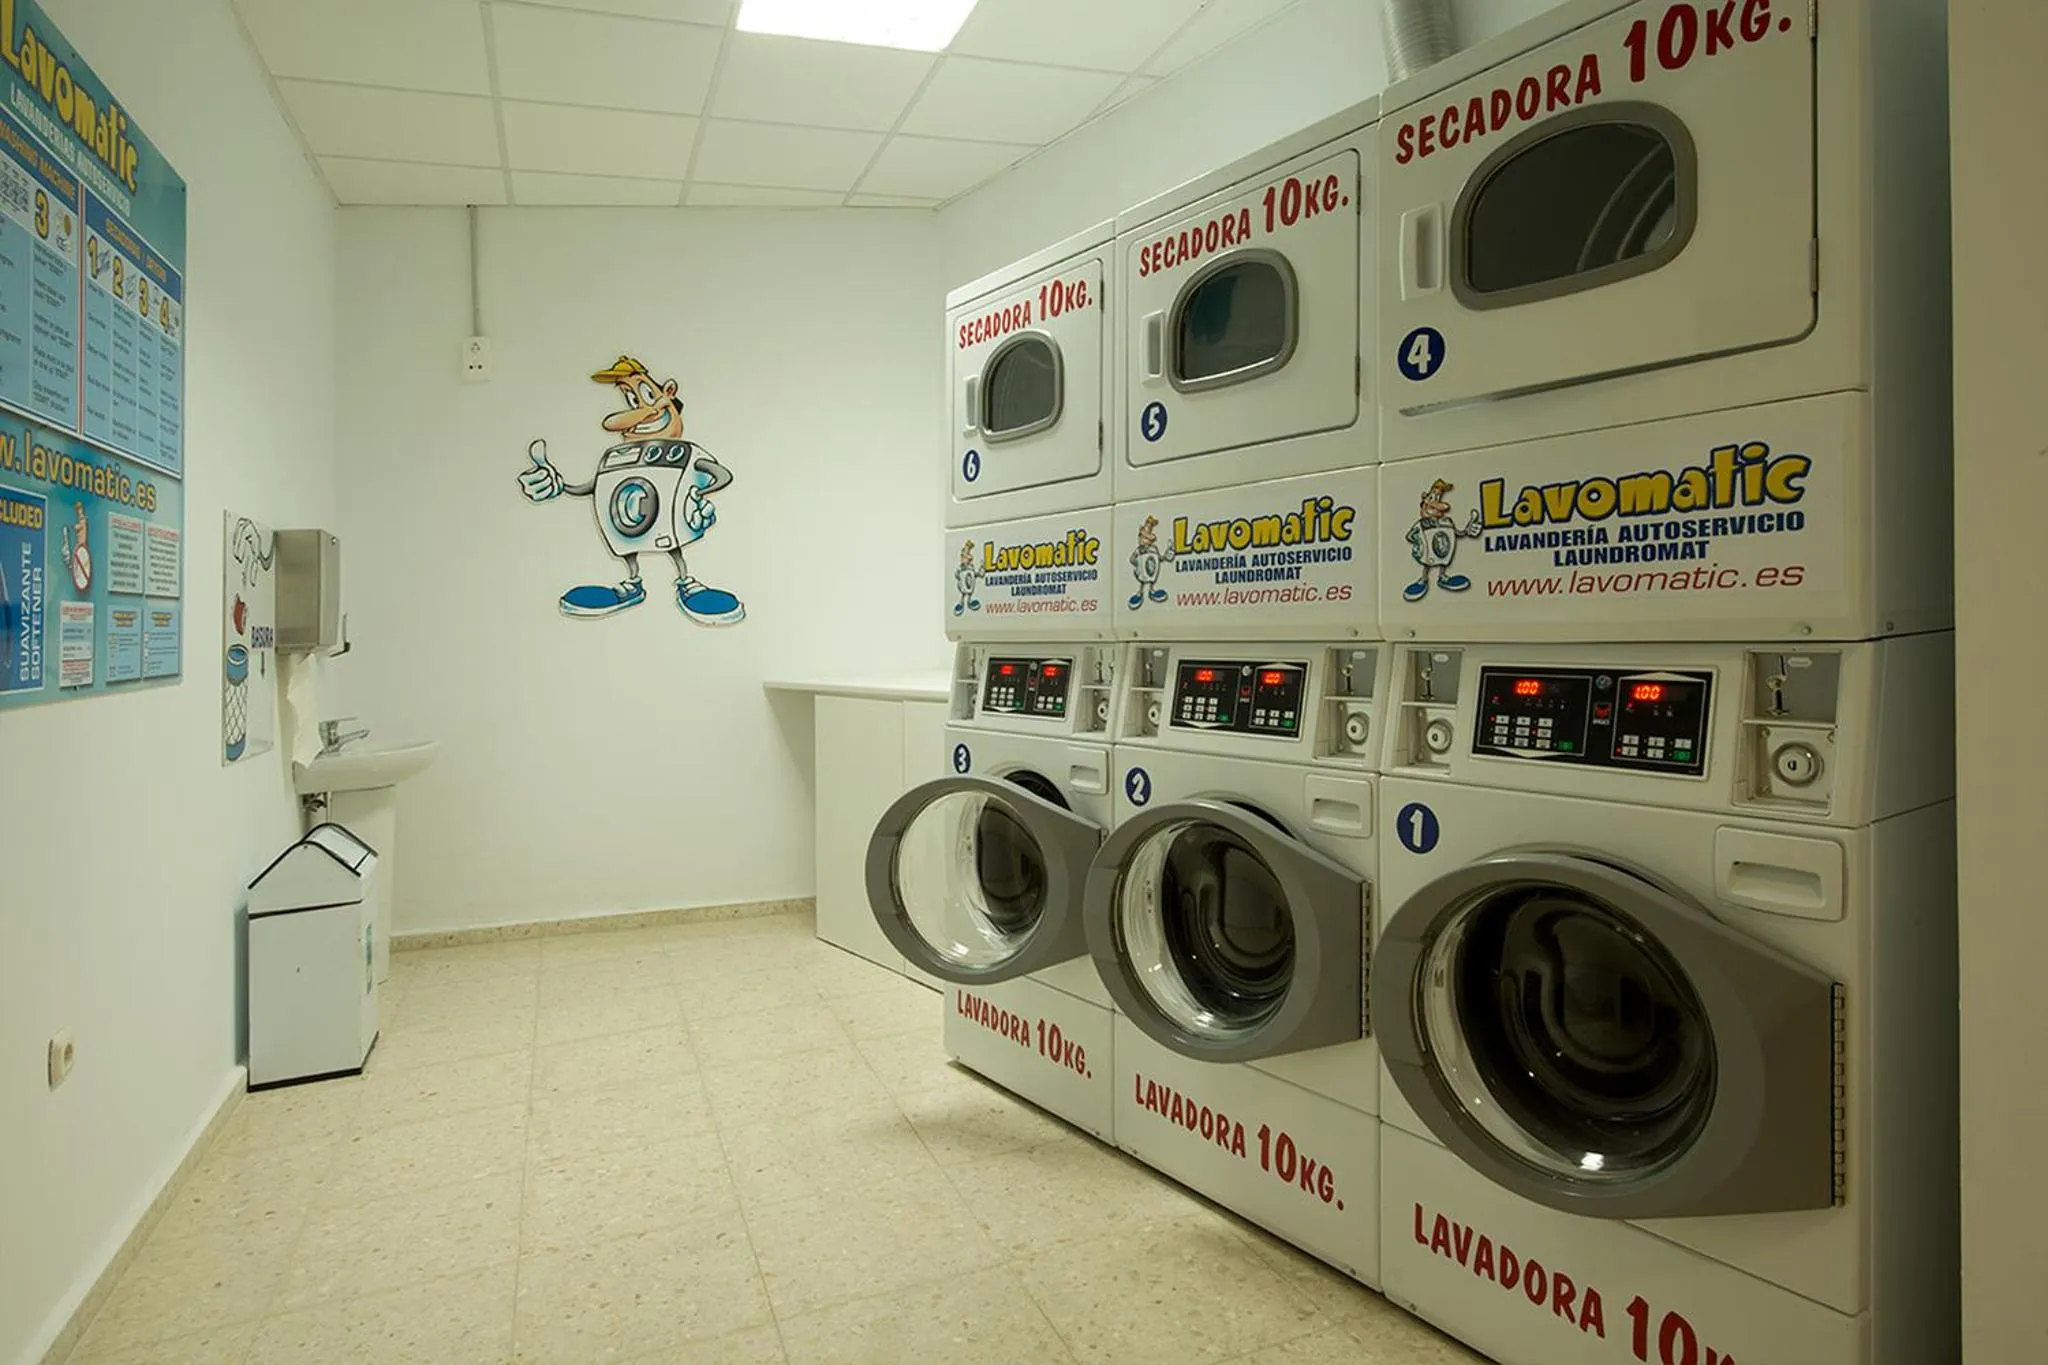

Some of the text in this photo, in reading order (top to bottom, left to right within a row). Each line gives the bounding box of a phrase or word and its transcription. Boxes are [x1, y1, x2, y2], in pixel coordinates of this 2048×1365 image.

[0, 0, 139, 196] Lavomatic
[1396, 54, 1602, 164] SECADORA
[35, 188, 49, 239] 3
[1139, 175, 1349, 277] SECADORA 10KG.
[88, 235, 98, 279] 1
[113, 256, 124, 299] 2
[139, 277, 149, 318] 3
[160, 296, 169, 334] 4
[958, 279, 1093, 349] SECADORA 10KG.
[1406, 333, 1432, 374] 4
[1148, 405, 1161, 438] 5
[966, 452, 978, 479] 6
[1480, 441, 1812, 529] Lavomatic
[1173, 496, 1356, 556] Lavomatic
[1484, 511, 1805, 553] LAVANDERÍA AUTOSERVICIO
[984, 529, 1100, 573] Lavomatic
[1175, 547, 1352, 573] LAVANDERÍA AUTOSERVICIO
[1553, 540, 1710, 567] LAUNDROMAT
[1011, 584, 1066, 597] LAUNDROMAT
[1035, 569, 1098, 584] AUTOSERVICIO
[1176, 582, 1352, 607] www.lavomatic.es
[1215, 566, 1302, 584] LAUNDROMAT
[1487, 563, 1806, 597] www.lavomatic.es
[20, 541, 32, 681] SUAVIZANTE
[31, 567, 42, 680] SOFTENER
[985, 597, 1098, 615] www.lavomatic.es
[958, 746, 968, 773] 3
[1131, 772, 1146, 802] 2
[1409, 808, 1425, 848] 1
[957, 988, 1093, 1079] LAVADORA 10KG.
[1135, 1073, 1345, 1211] LAVADORA 10KG.
[1413, 1202, 1606, 1339] LAVADORA
